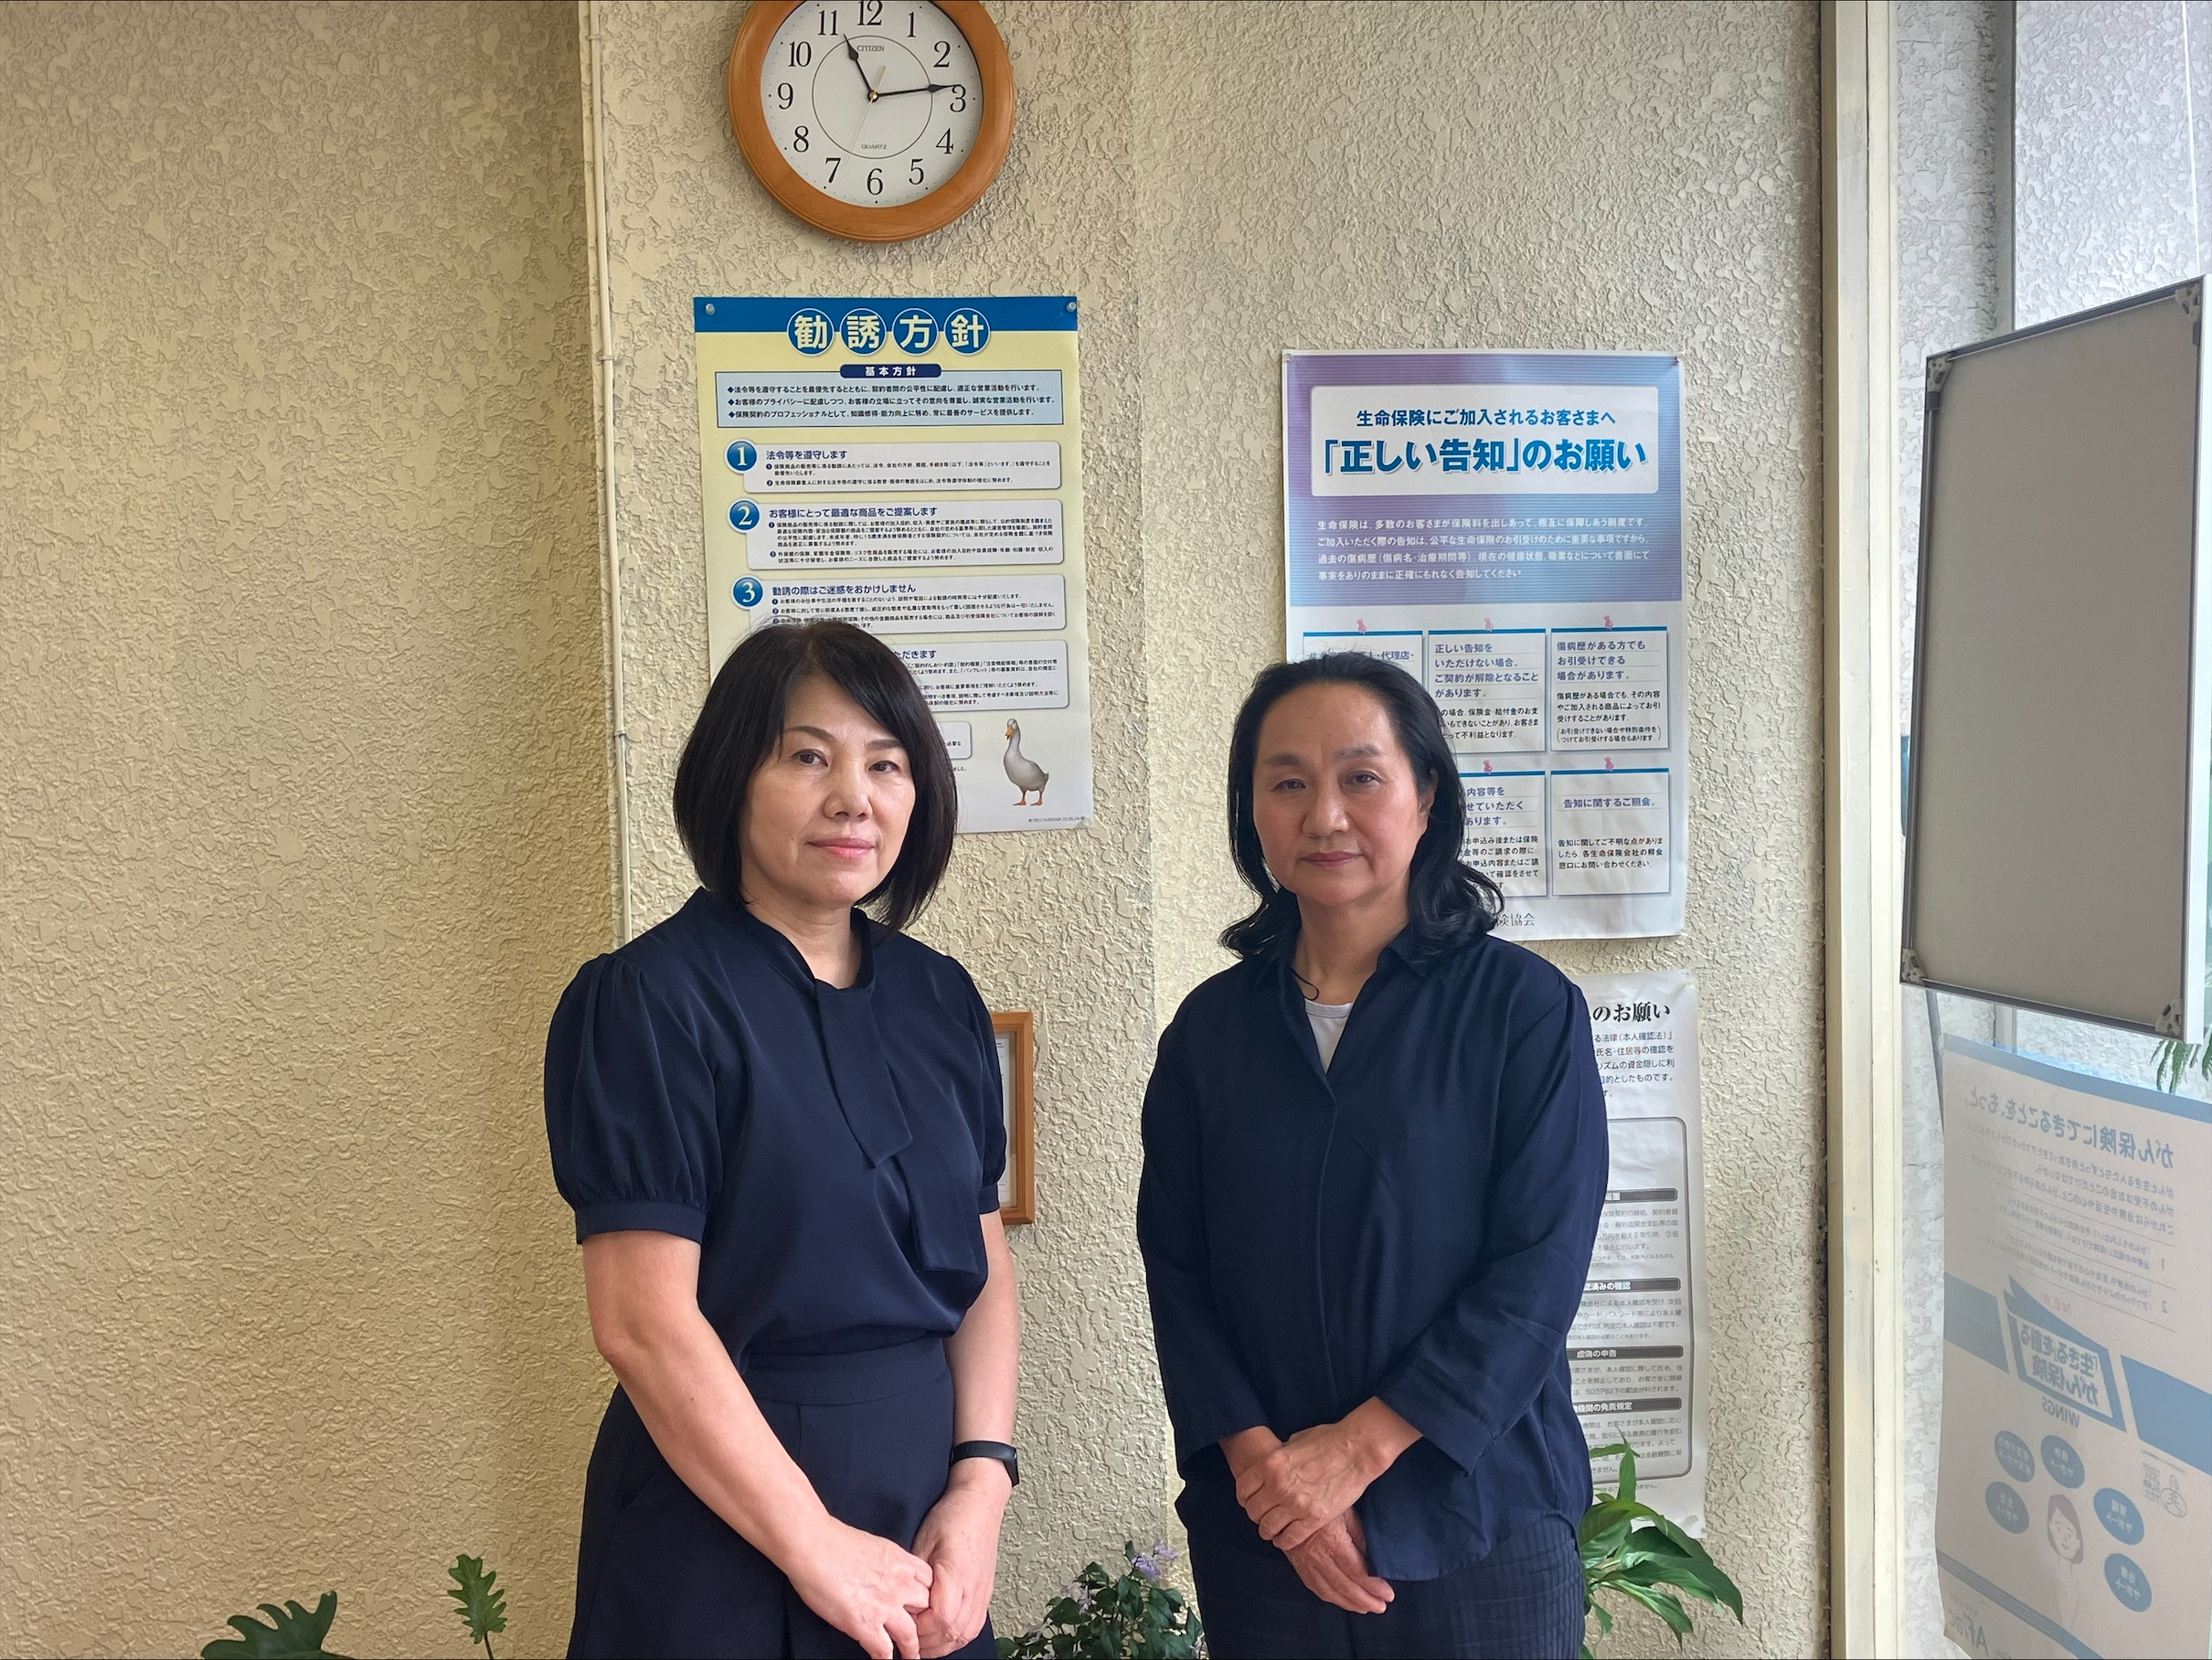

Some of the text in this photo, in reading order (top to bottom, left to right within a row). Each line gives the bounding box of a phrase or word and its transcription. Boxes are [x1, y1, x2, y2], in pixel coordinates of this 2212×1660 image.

[818, 10, 838, 36] 11
[856, 0, 883, 26] 12
[907, 11, 917, 37] 1
[788, 41, 812, 67] 10
[933, 41, 950, 68] 2
[777, 82, 793, 110] 9
[950, 84, 966, 112] 3
[792, 126, 810, 153] 8
[935, 128, 954, 154] 4
[824, 157, 841, 183] 7
[909, 158, 924, 185] 5
[867, 168, 883, 195] 6
[793, 314, 984, 350] 勧誘方針
[865, 366, 916, 377] 基本方針
[1356, 409, 1616, 428] 生命保険にご加入されるお客さまへ
[738, 446, 747, 466] 1
[766, 451, 847, 461] 法令等を遵守します
[1324, 438, 1646, 474] 「正しい告知」のお願い
[739, 505, 752, 526] 2
[769, 507, 938, 518] お客様にとって最適な商品をご提案します
[742, 582, 755, 603] 3
[772, 584, 916, 595] 勧誘の際はご迷惑をおかけしません
[1435, 644, 1493, 654] 正しい告知を
[1557, 641, 1645, 651] 傷病歴がある方でも
[1435, 658, 1518, 668] いただけない場合、
[1558, 655, 1625, 665] お引受けできる
[1435, 673, 1538, 683] ご契約が解除となること
[1557, 671, 1629, 680] 場合があります。
[1435, 688, 1486, 697] があります。
[1467, 787, 1505, 796] 内容等を
[1564, 797, 1654, 808] 告知に関するご照会。
[1463, 835, 1538, 844] お申込み後または保険
[1558, 837, 1663, 846] 告知に関してご不明な点がありま
[1592, 1001, 1671, 1022] のお願い
